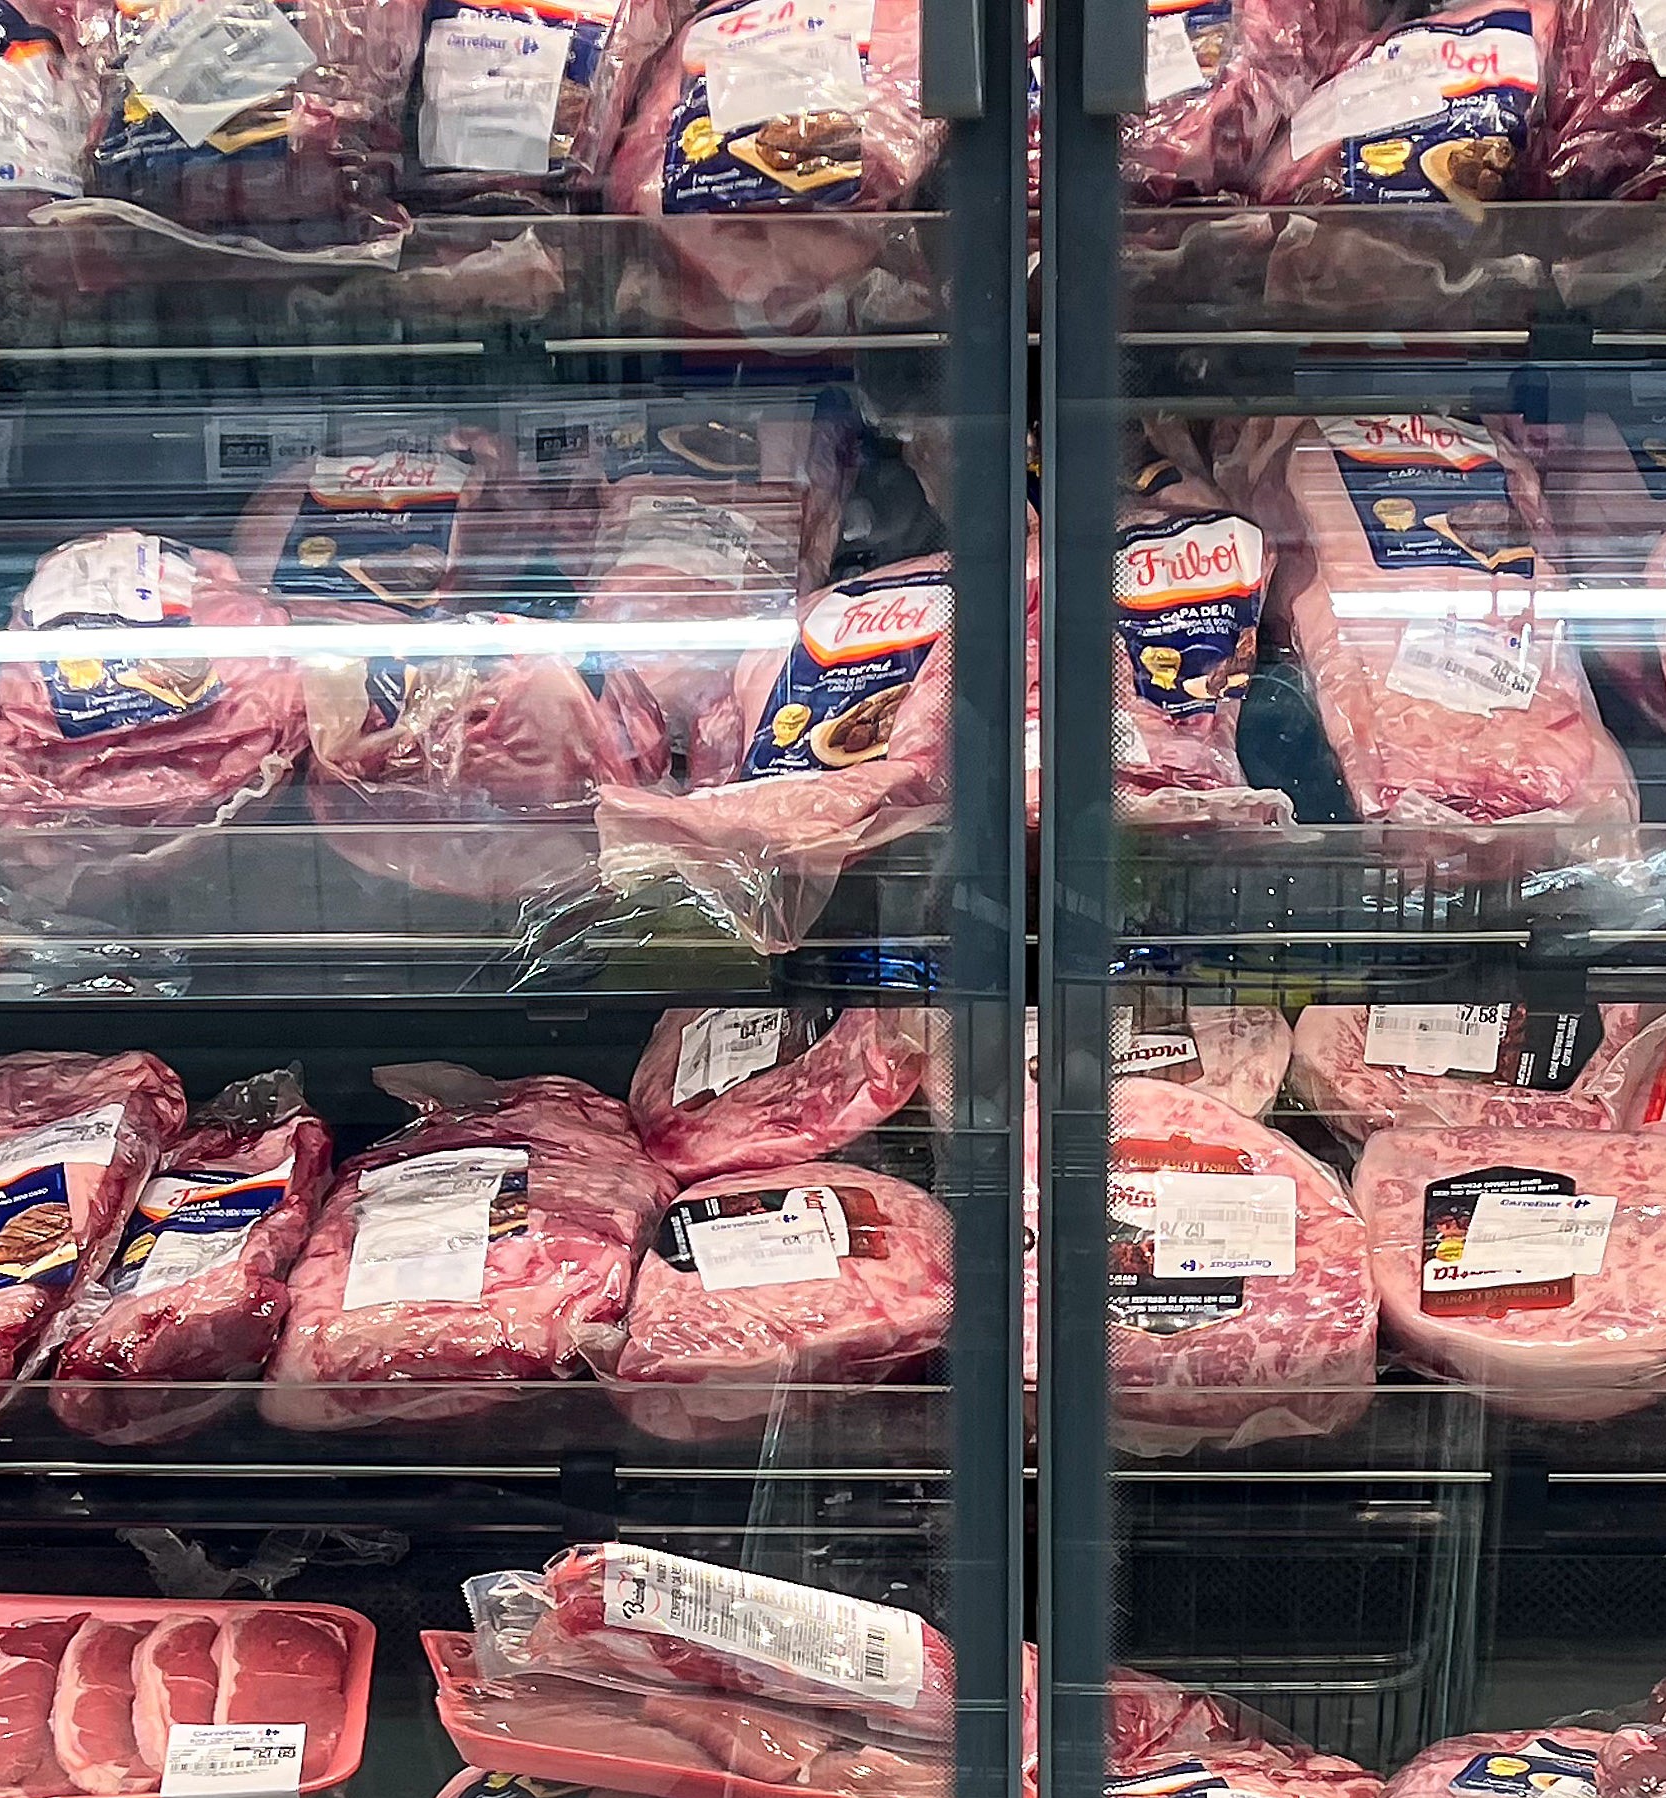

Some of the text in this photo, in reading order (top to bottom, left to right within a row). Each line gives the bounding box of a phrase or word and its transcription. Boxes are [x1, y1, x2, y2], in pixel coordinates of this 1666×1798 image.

[1128, 533, 1245, 586] Friboi
[834, 595, 935, 643] Friboi
[1160, 608, 1197, 624] CAPA
[1199, 606, 1216, 619] DE
[1457, 1006, 1498, 1025] 7.58
[1499, 1198, 1563, 1209] Carrefour
[1209, 1258, 1271, 1269] Carrefour
